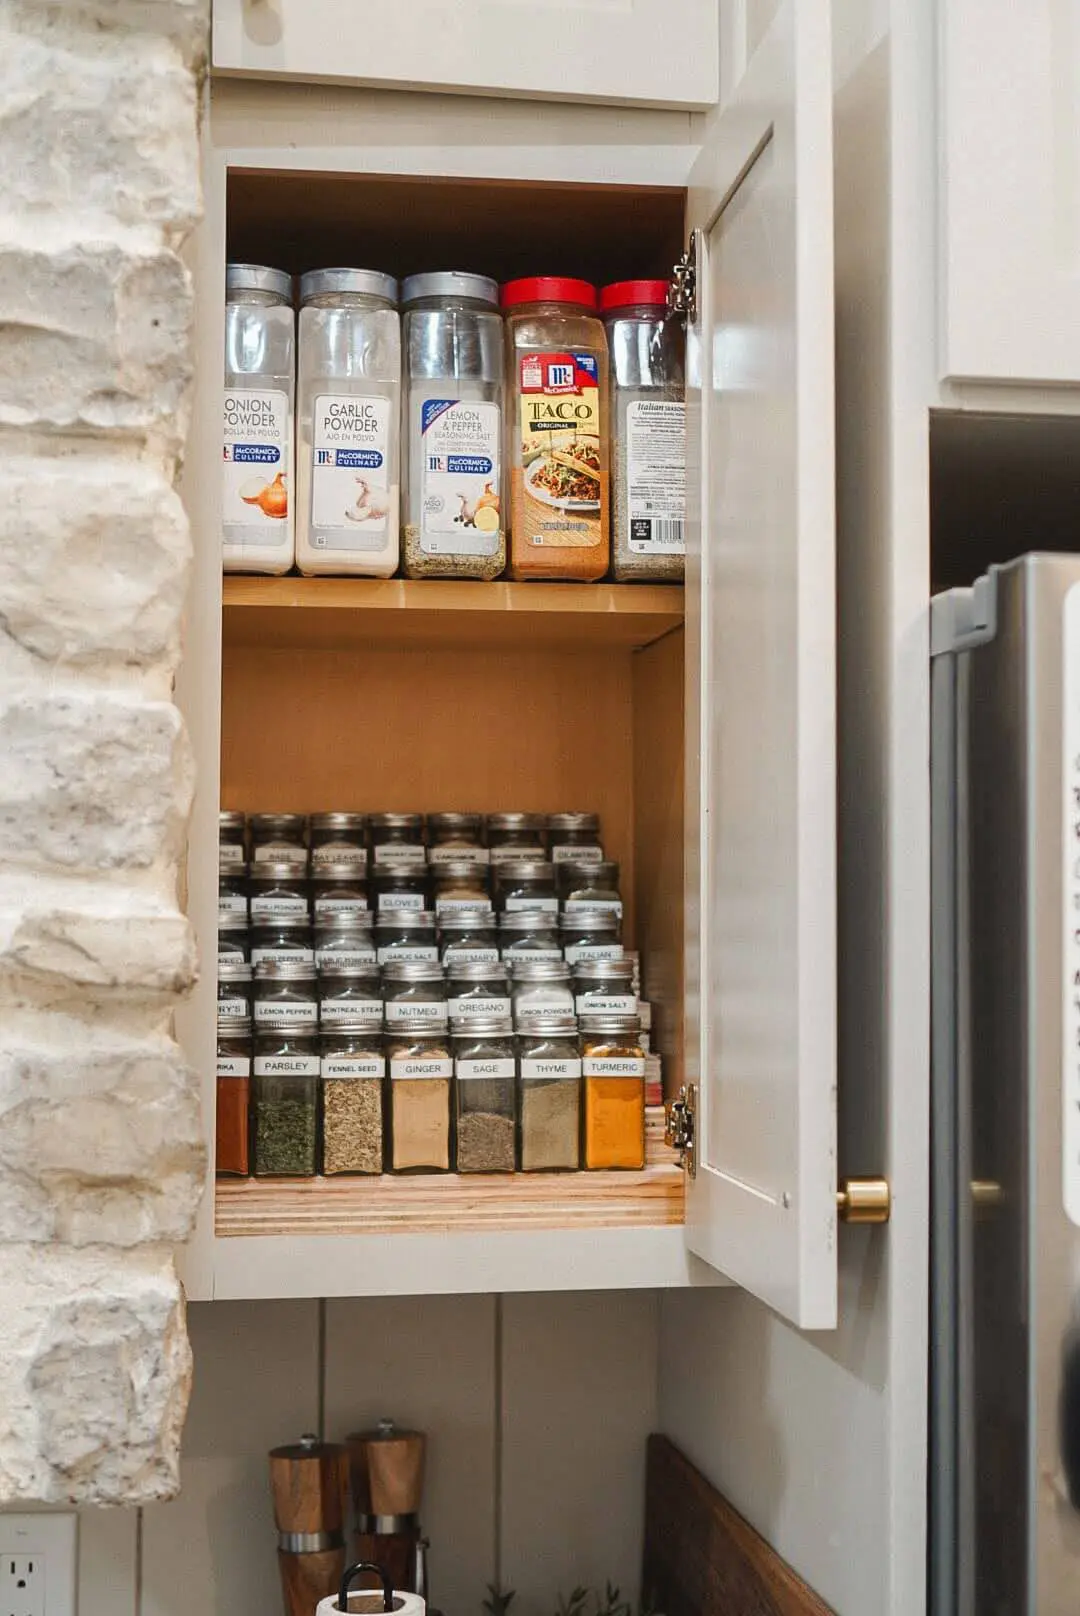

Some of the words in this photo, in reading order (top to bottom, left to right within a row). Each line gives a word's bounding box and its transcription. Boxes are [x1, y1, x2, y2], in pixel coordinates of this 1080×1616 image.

[544, 386, 578, 394] McCormick
[225, 399, 272, 413] ONION
[329, 404, 373, 418] GARLIC
[528, 402, 592, 420] TACO
[446, 411, 479, 421] LEMON
[324, 417, 378, 432] POWDER
[442, 422, 449, 430] &
[452, 422, 482, 432] PEPPER
[338, 459, 379, 467] CULINARY
[398, 1008, 438, 1016] NUTMEG
[459, 1004, 504, 1012] OREGANO
[264, 1062, 308, 1070] PARSLEY
[406, 1065, 442, 1073] GINGER
[473, 1065, 498, 1073] SAGE
[592, 1063, 638, 1072] TURMERIC
